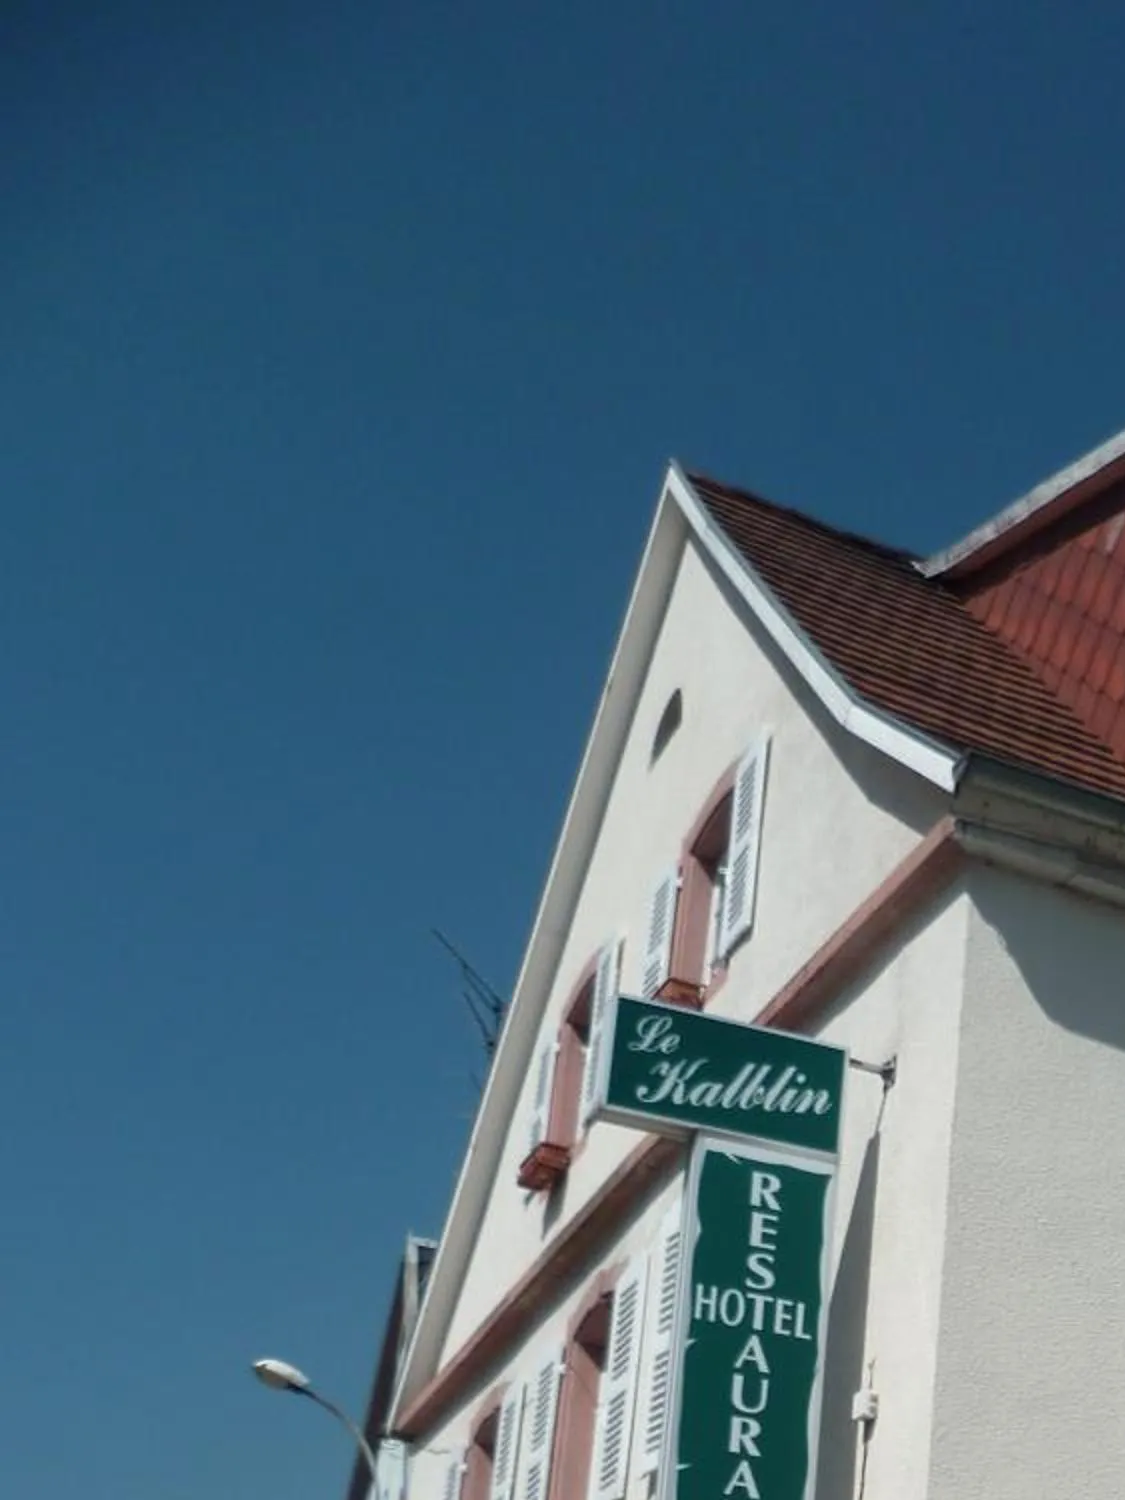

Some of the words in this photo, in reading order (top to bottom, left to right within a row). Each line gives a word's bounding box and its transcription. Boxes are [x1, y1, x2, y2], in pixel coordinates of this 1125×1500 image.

[628, 1014, 681, 1055] Le
[635, 1058, 833, 1116] Kalblin
[693, 1283, 812, 1341] HOTEL
